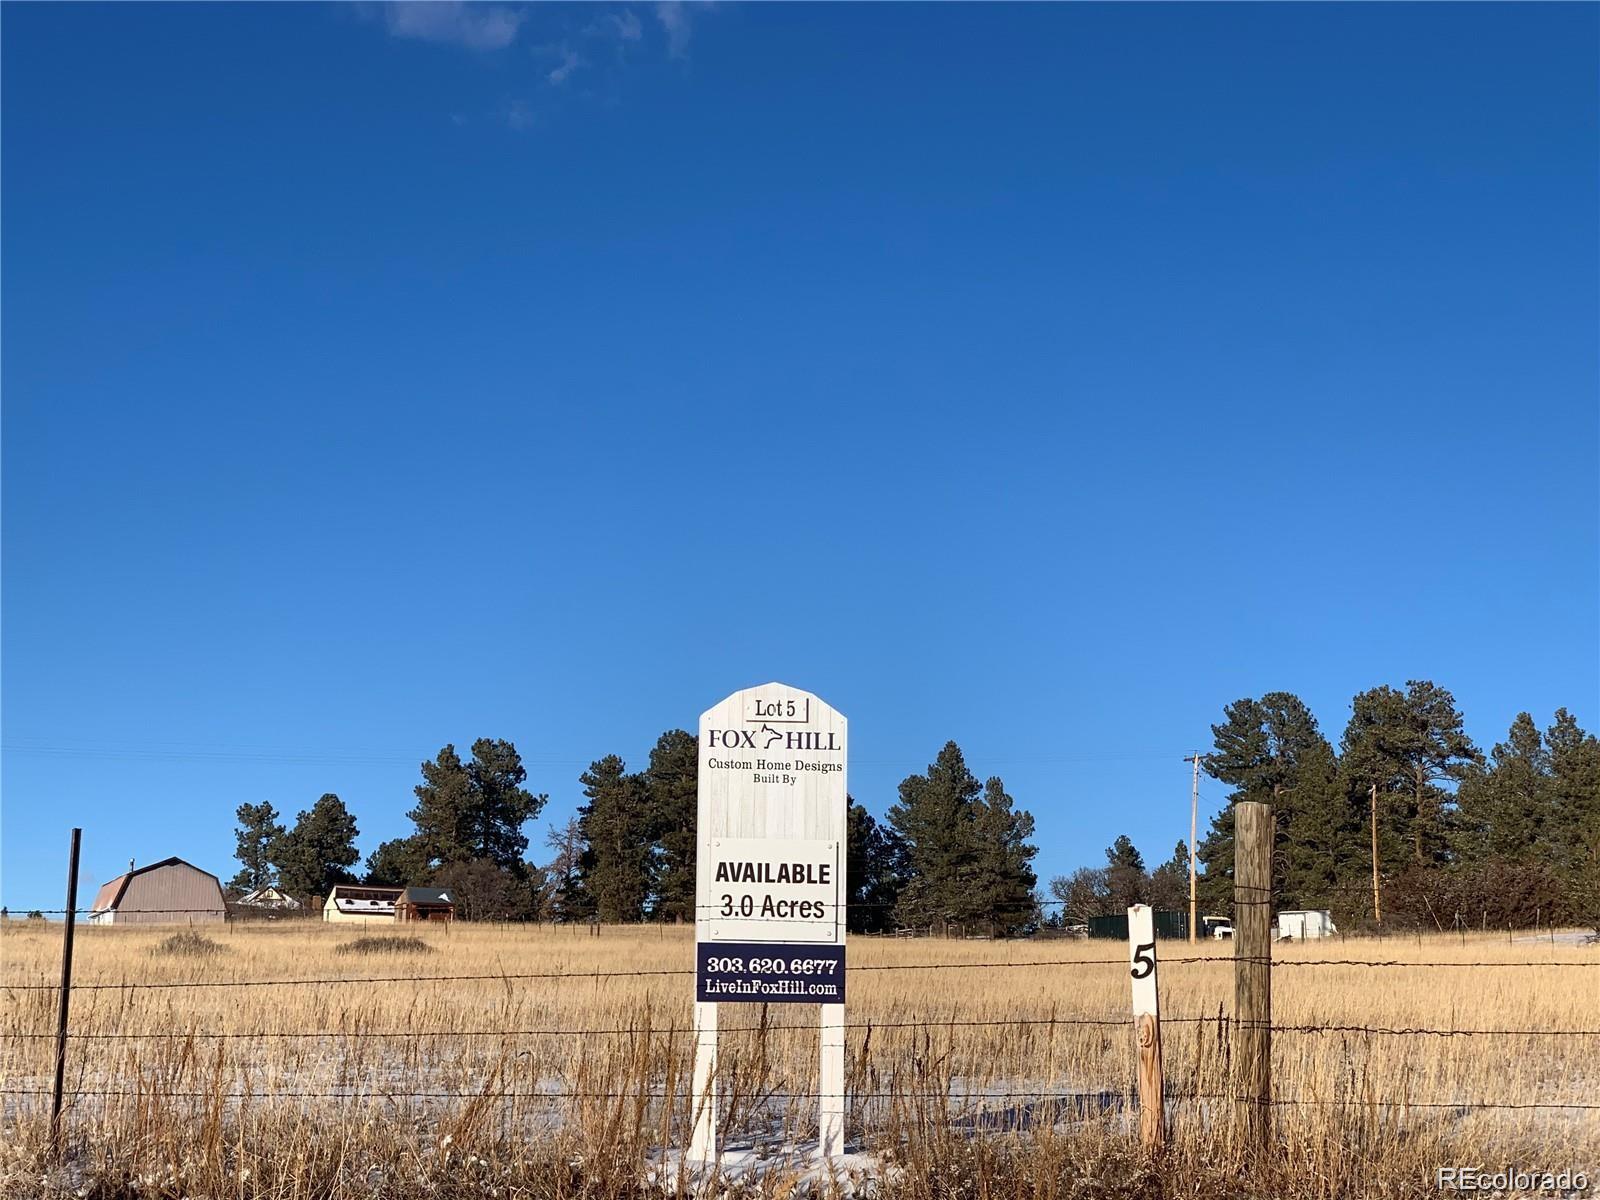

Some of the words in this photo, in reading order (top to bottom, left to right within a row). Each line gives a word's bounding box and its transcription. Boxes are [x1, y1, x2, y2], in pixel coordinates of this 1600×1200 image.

[755, 699, 782, 717] Lot
[786, 700, 796, 717] 5
[708, 729, 757, 749] FOX
[785, 732, 841, 751] HILL
[708, 758, 752, 770] Custom
[756, 760, 791, 771] Home
[795, 760, 843, 774] Designs
[753, 774, 779, 784] Built
[782, 775, 797, 786] By
[715, 862, 830, 884] AVAILABLE
[720, 894, 754, 917] 3.0
[760, 895, 825, 919] Acres
[707, 957, 838, 975] 303.620.6677
[1130, 942, 1155, 979] 5
[705, 979, 838, 995] LiveInFoxHill.com
